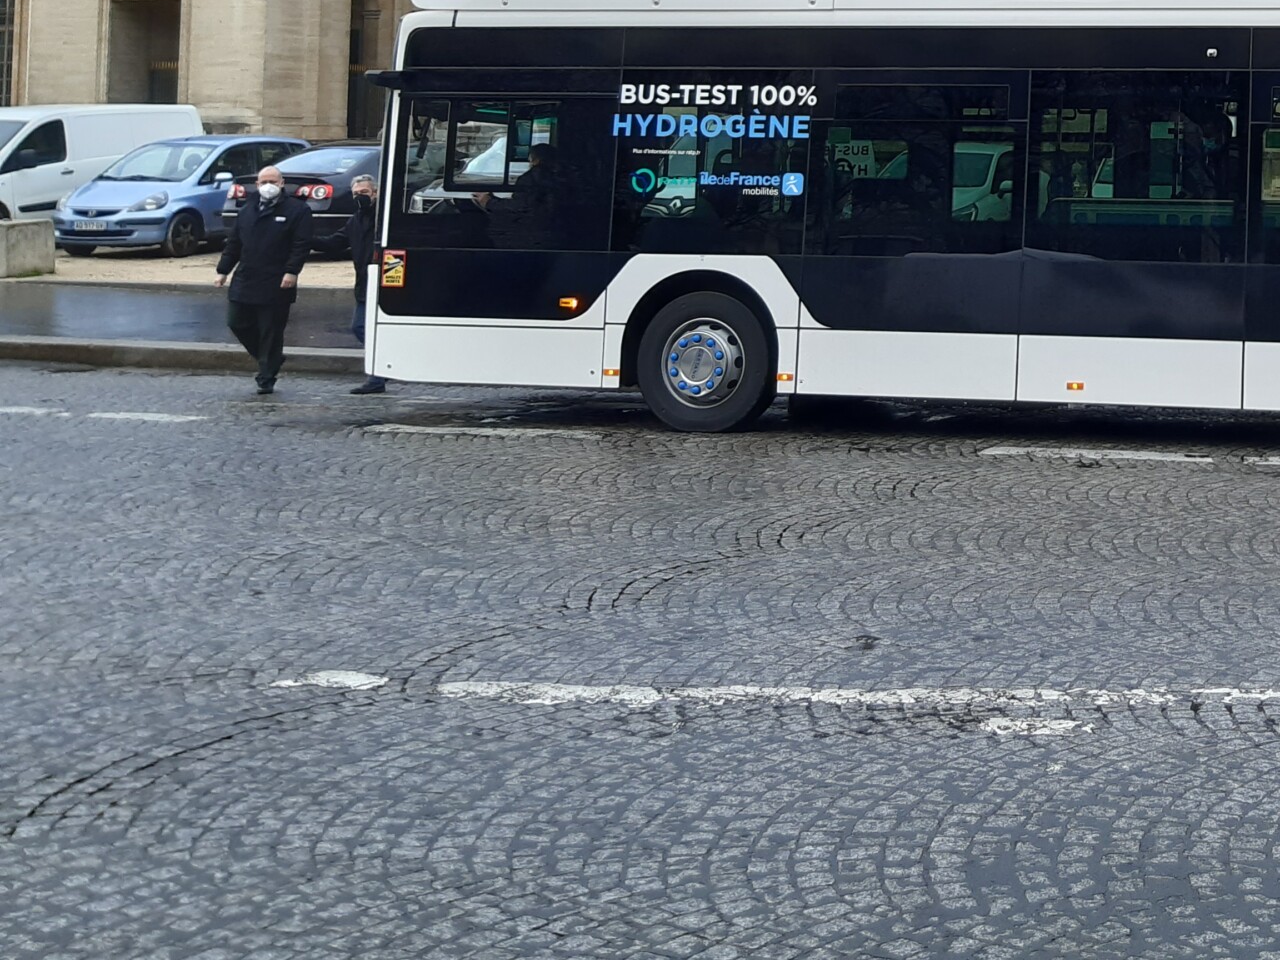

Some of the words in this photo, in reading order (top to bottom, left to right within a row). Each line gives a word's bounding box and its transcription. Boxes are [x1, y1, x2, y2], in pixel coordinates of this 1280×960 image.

[620, 84, 743, 105] BUS-TEST
[750, 85, 817, 106] 100%
[612, 108, 810, 138] HYDROGÈNE
[658, 177, 697, 186] RATP
[742, 186, 779, 196] mobilités
